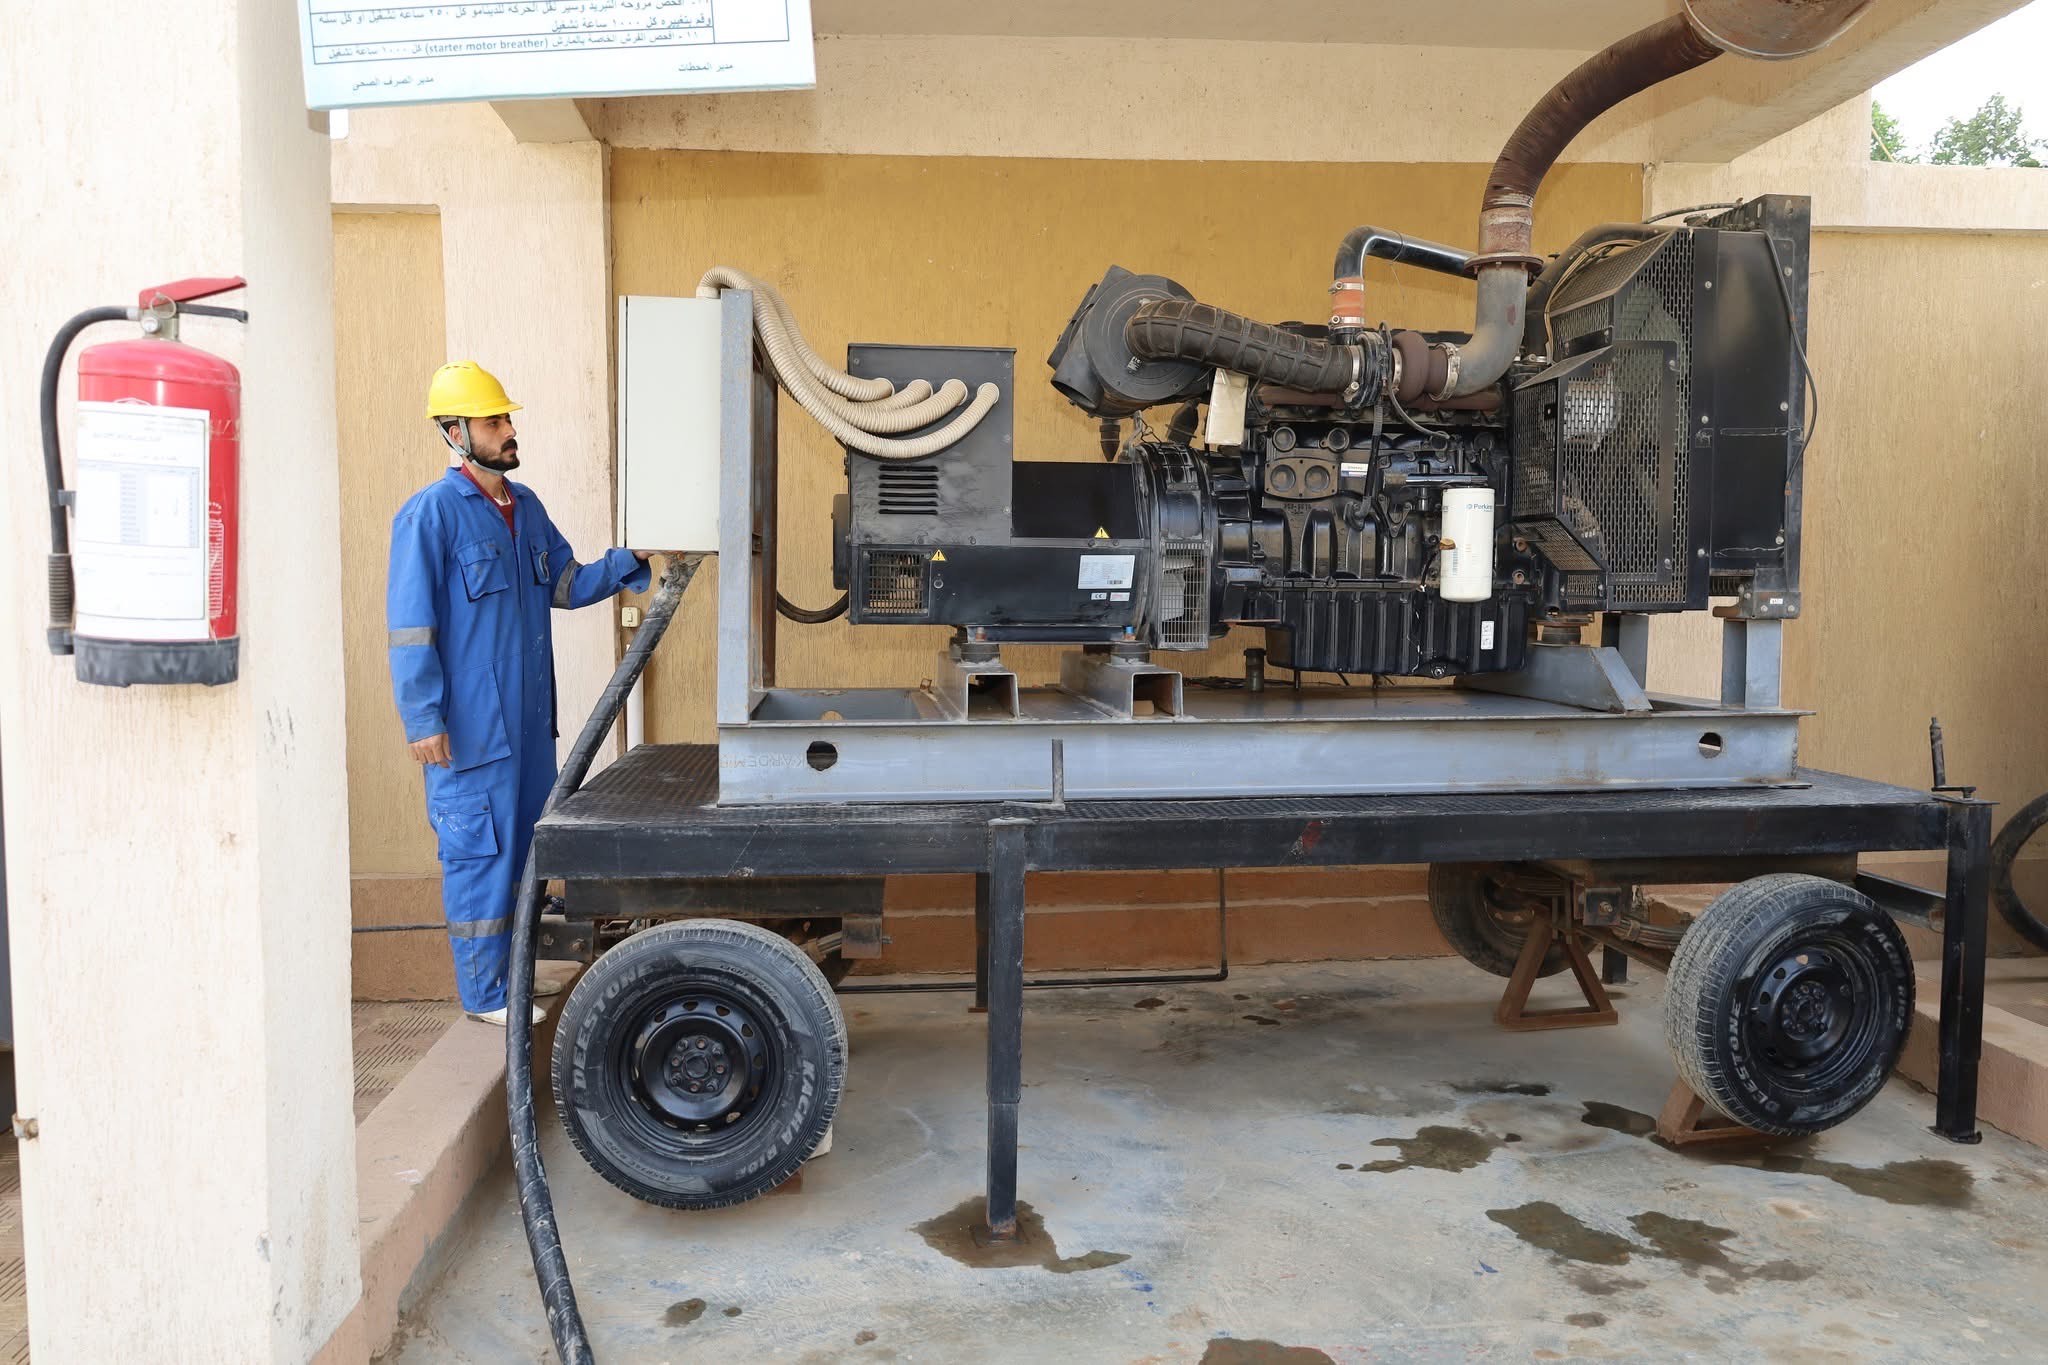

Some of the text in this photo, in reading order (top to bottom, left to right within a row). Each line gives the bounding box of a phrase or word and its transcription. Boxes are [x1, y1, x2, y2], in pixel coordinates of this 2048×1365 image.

[455, 8, 467, 18] كل
[646, 17, 658, 28] كل
[425, 42, 463, 56] (starter
[465, 42, 497, 51] motor
[500, 38, 549, 51] breather)
[572, 960, 656, 1090] DEESTONE
[780, 1058, 817, 1146] KACHA
